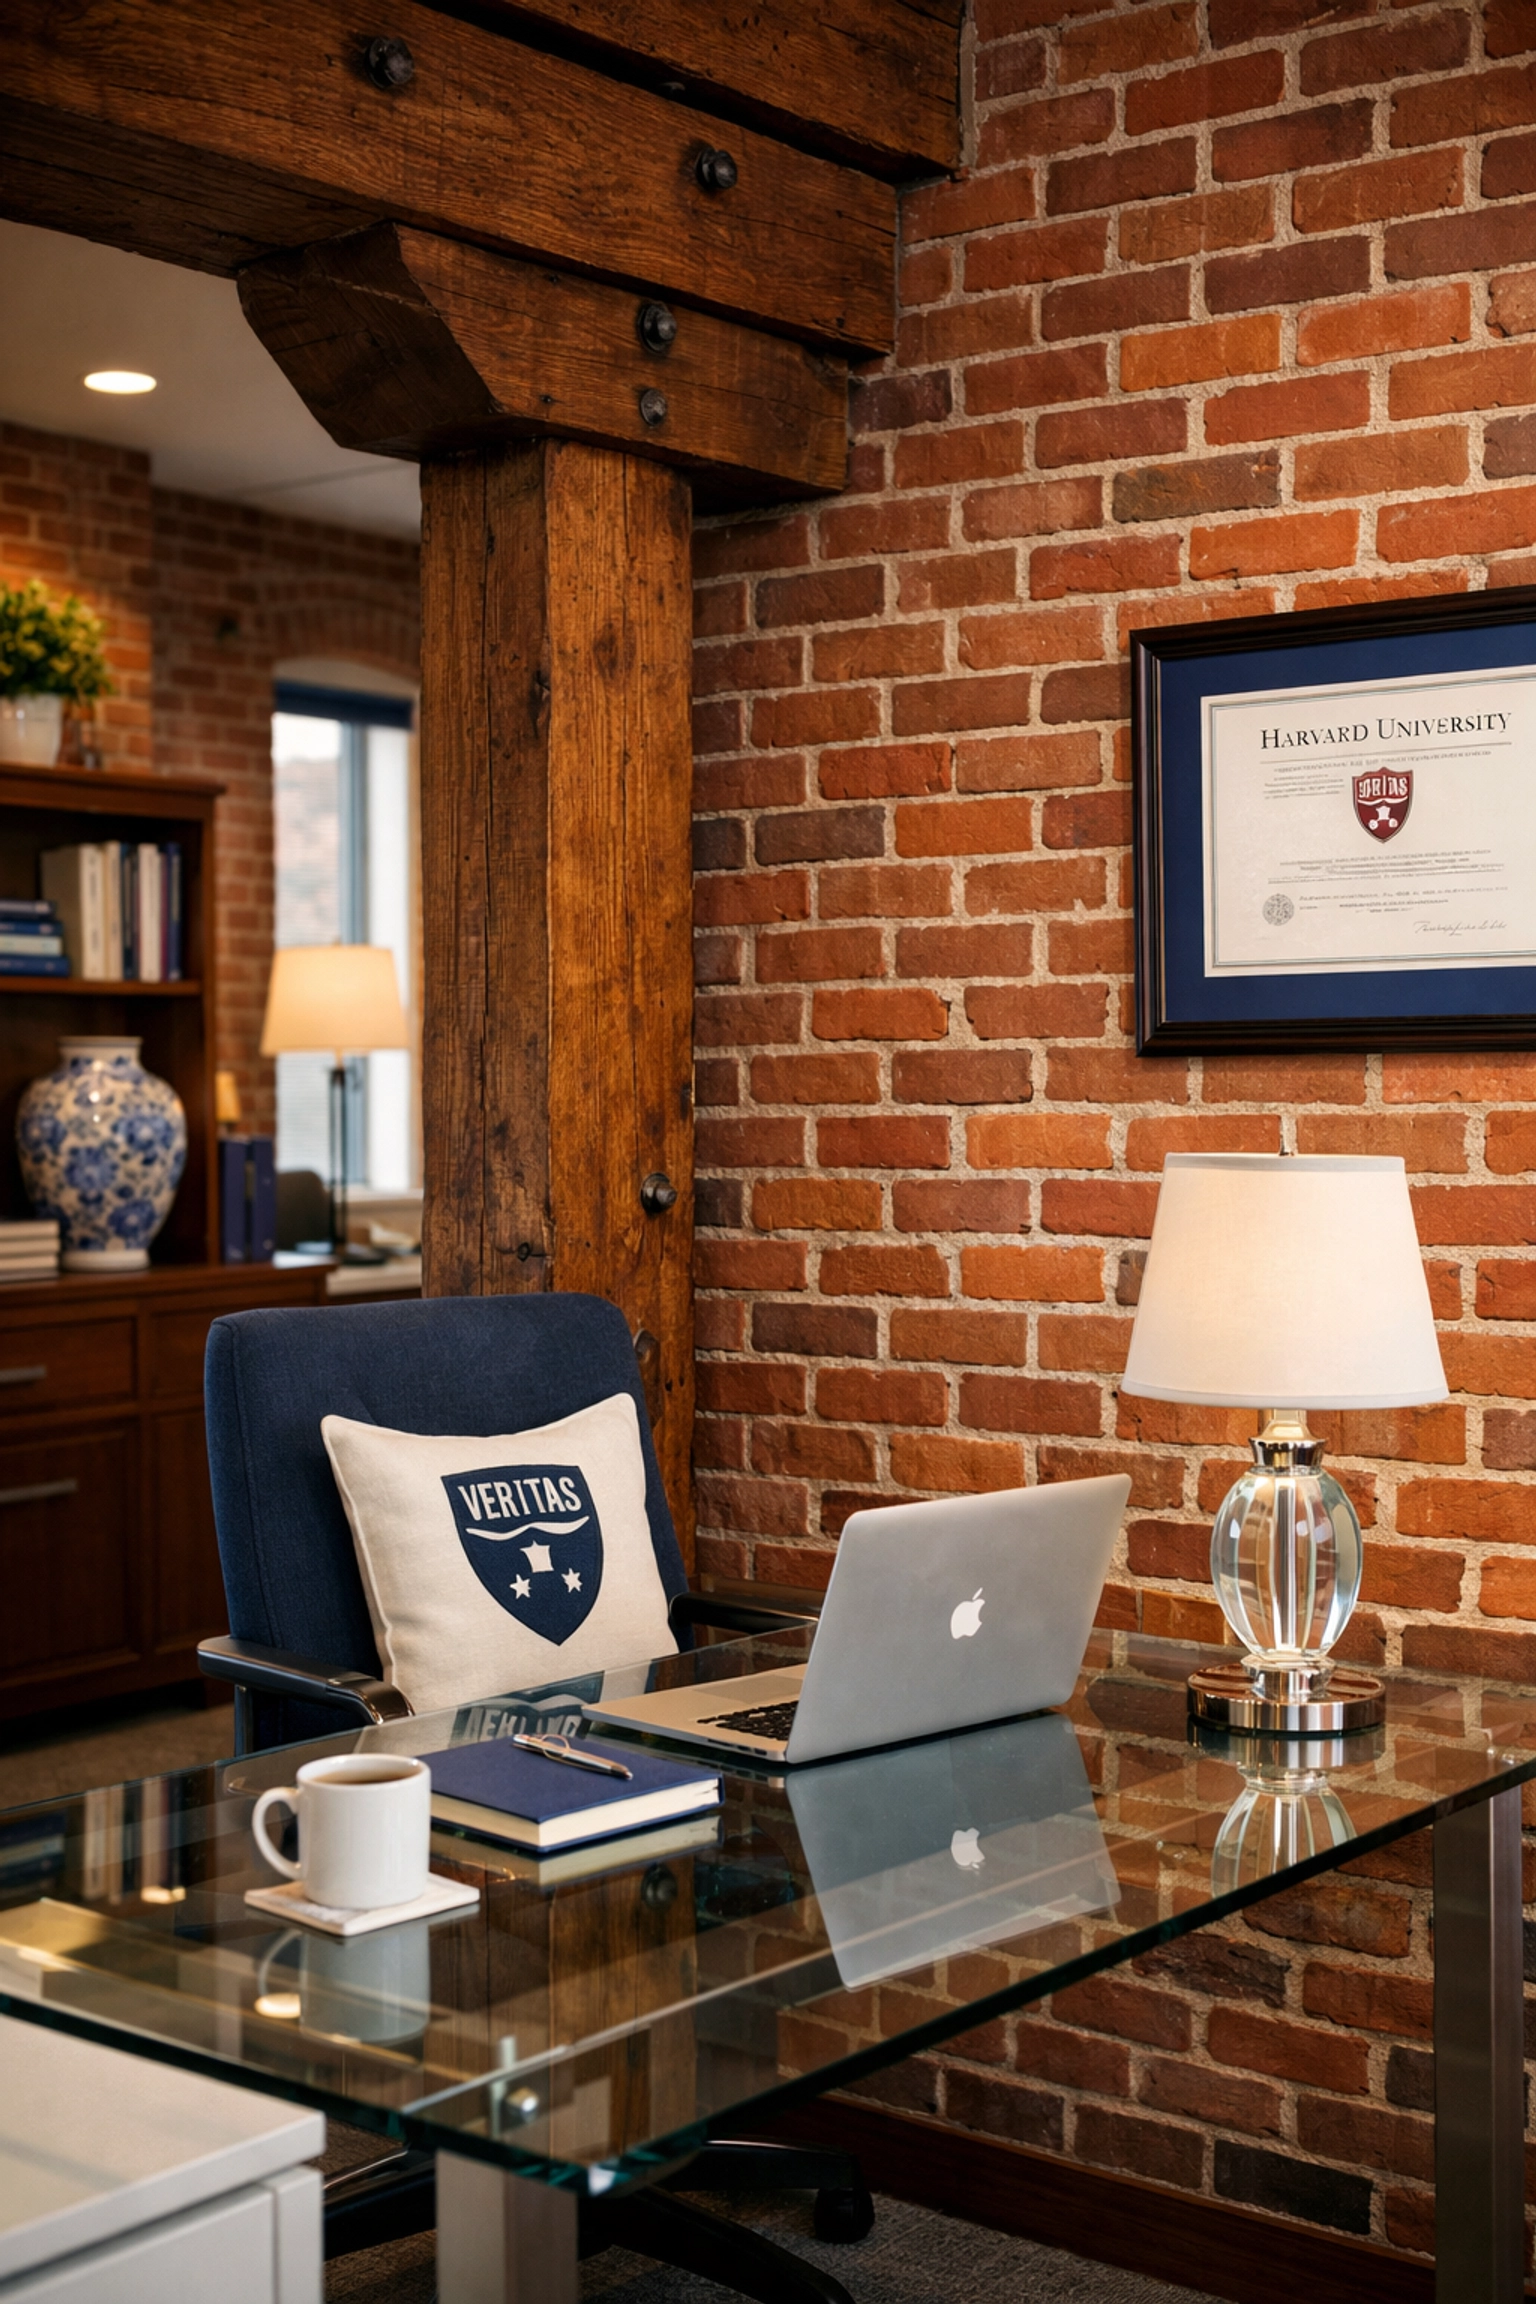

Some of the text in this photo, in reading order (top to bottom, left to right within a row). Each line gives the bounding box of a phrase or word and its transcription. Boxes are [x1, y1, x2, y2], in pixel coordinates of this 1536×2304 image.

[1260, 712, 1512, 749] HARVARD UNIVERSITY
[457, 1476, 582, 1521] VERITAS
